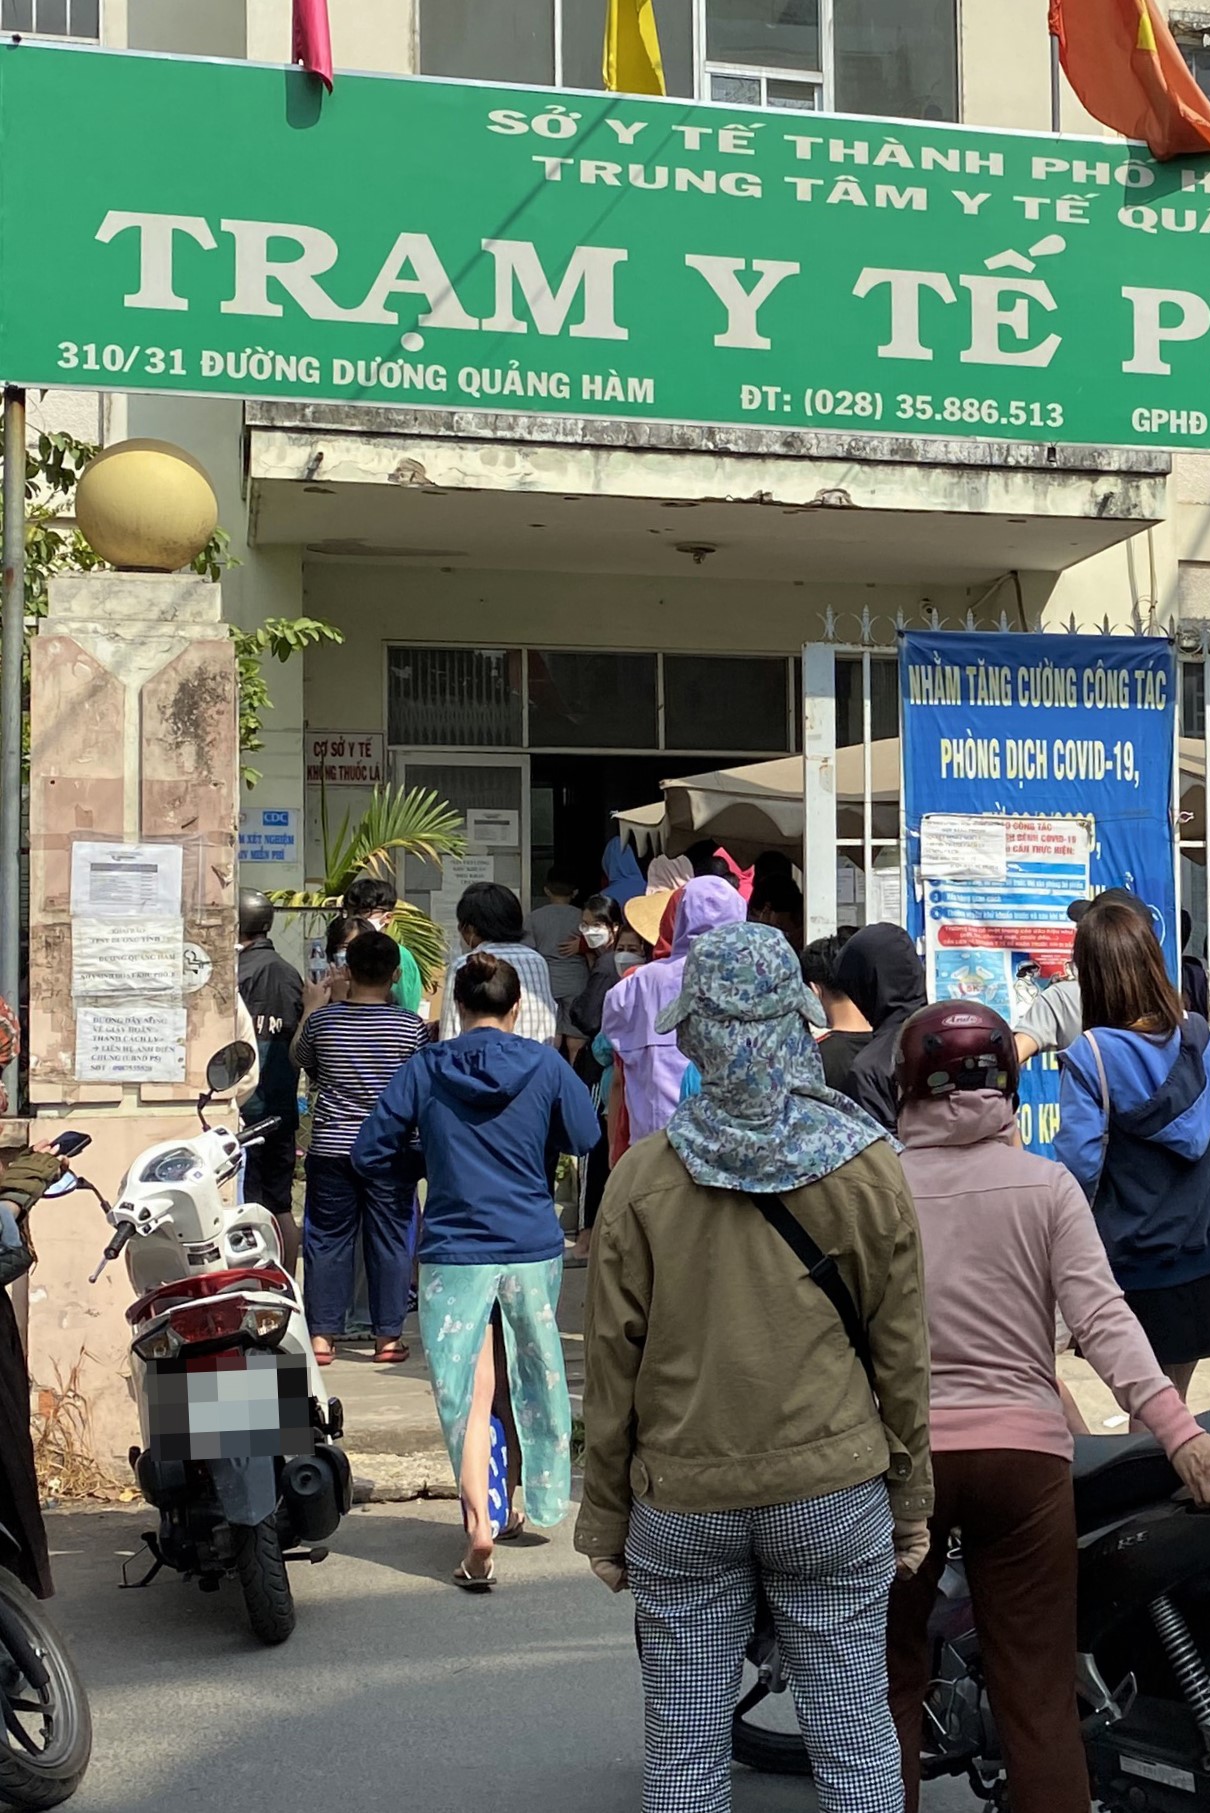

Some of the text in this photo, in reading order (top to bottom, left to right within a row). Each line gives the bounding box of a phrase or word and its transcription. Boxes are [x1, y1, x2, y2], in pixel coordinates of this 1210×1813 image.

[487, 105, 581, 140] SỞ
[604, 120, 649, 145] Y
[671, 122, 766, 156] TẾ
[783, 136, 1004, 176] THÀNH
[1031, 156, 1157, 188] PHỐ
[532, 155, 762, 199] TRUNG
[784, 174, 928, 211] TÂM
[951, 190, 991, 215] Y
[1012, 192, 1100, 225] TẾ
[95, 210, 629, 352] TRẠM
[685, 254, 800, 351] Y
[852, 234, 1067, 368] TẾ
[57, 341, 654, 404] 310/31 ĐƯỜNG DƯƠNG QUẢNG HÀM
[740, 384, 1064, 428] ĐT: (028) 35.886.513
[1132, 407, 1208, 435] GPHĐ
[908, 651, 1167, 710] NHẰM TĂNG CƯỜNG CÔNG TÁC
[348, 742, 355, 757] Y
[940, 728, 1140, 788] PHÒNG DỊCH COVID-19,
[264, 812, 289, 823] CDC
